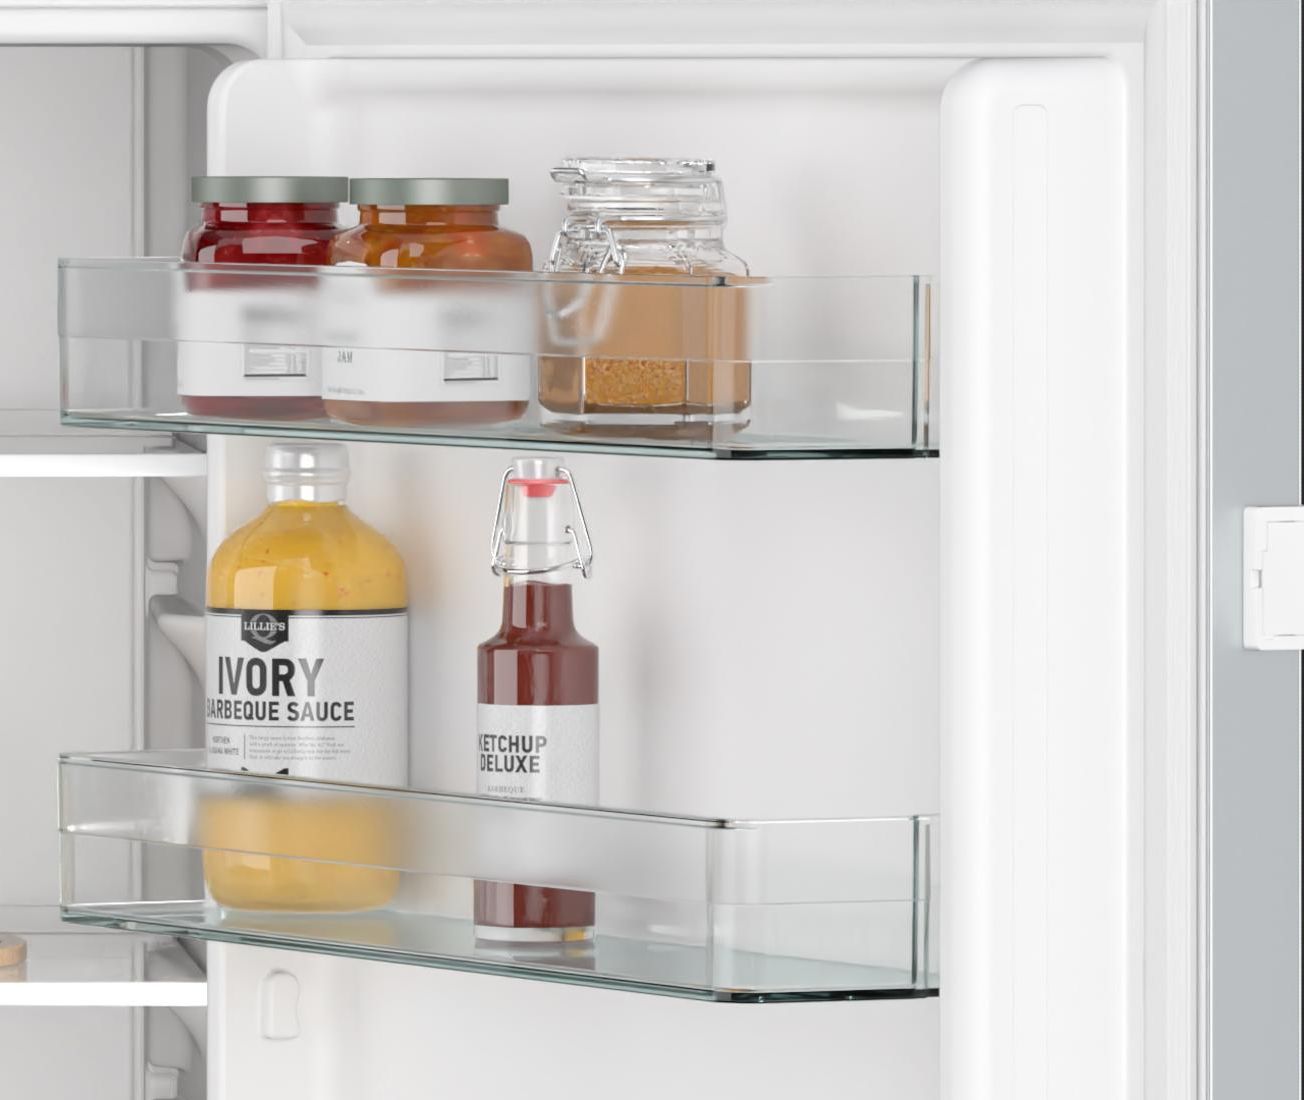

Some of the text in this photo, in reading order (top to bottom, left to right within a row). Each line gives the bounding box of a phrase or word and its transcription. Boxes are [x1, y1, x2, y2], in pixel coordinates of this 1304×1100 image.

[218, 656, 325, 697] IVORY
[206, 697, 355, 722] BARBEQUE SAUCE
[478, 733, 547, 754] KETCHUP
[480, 754, 541, 774] DELUXE
